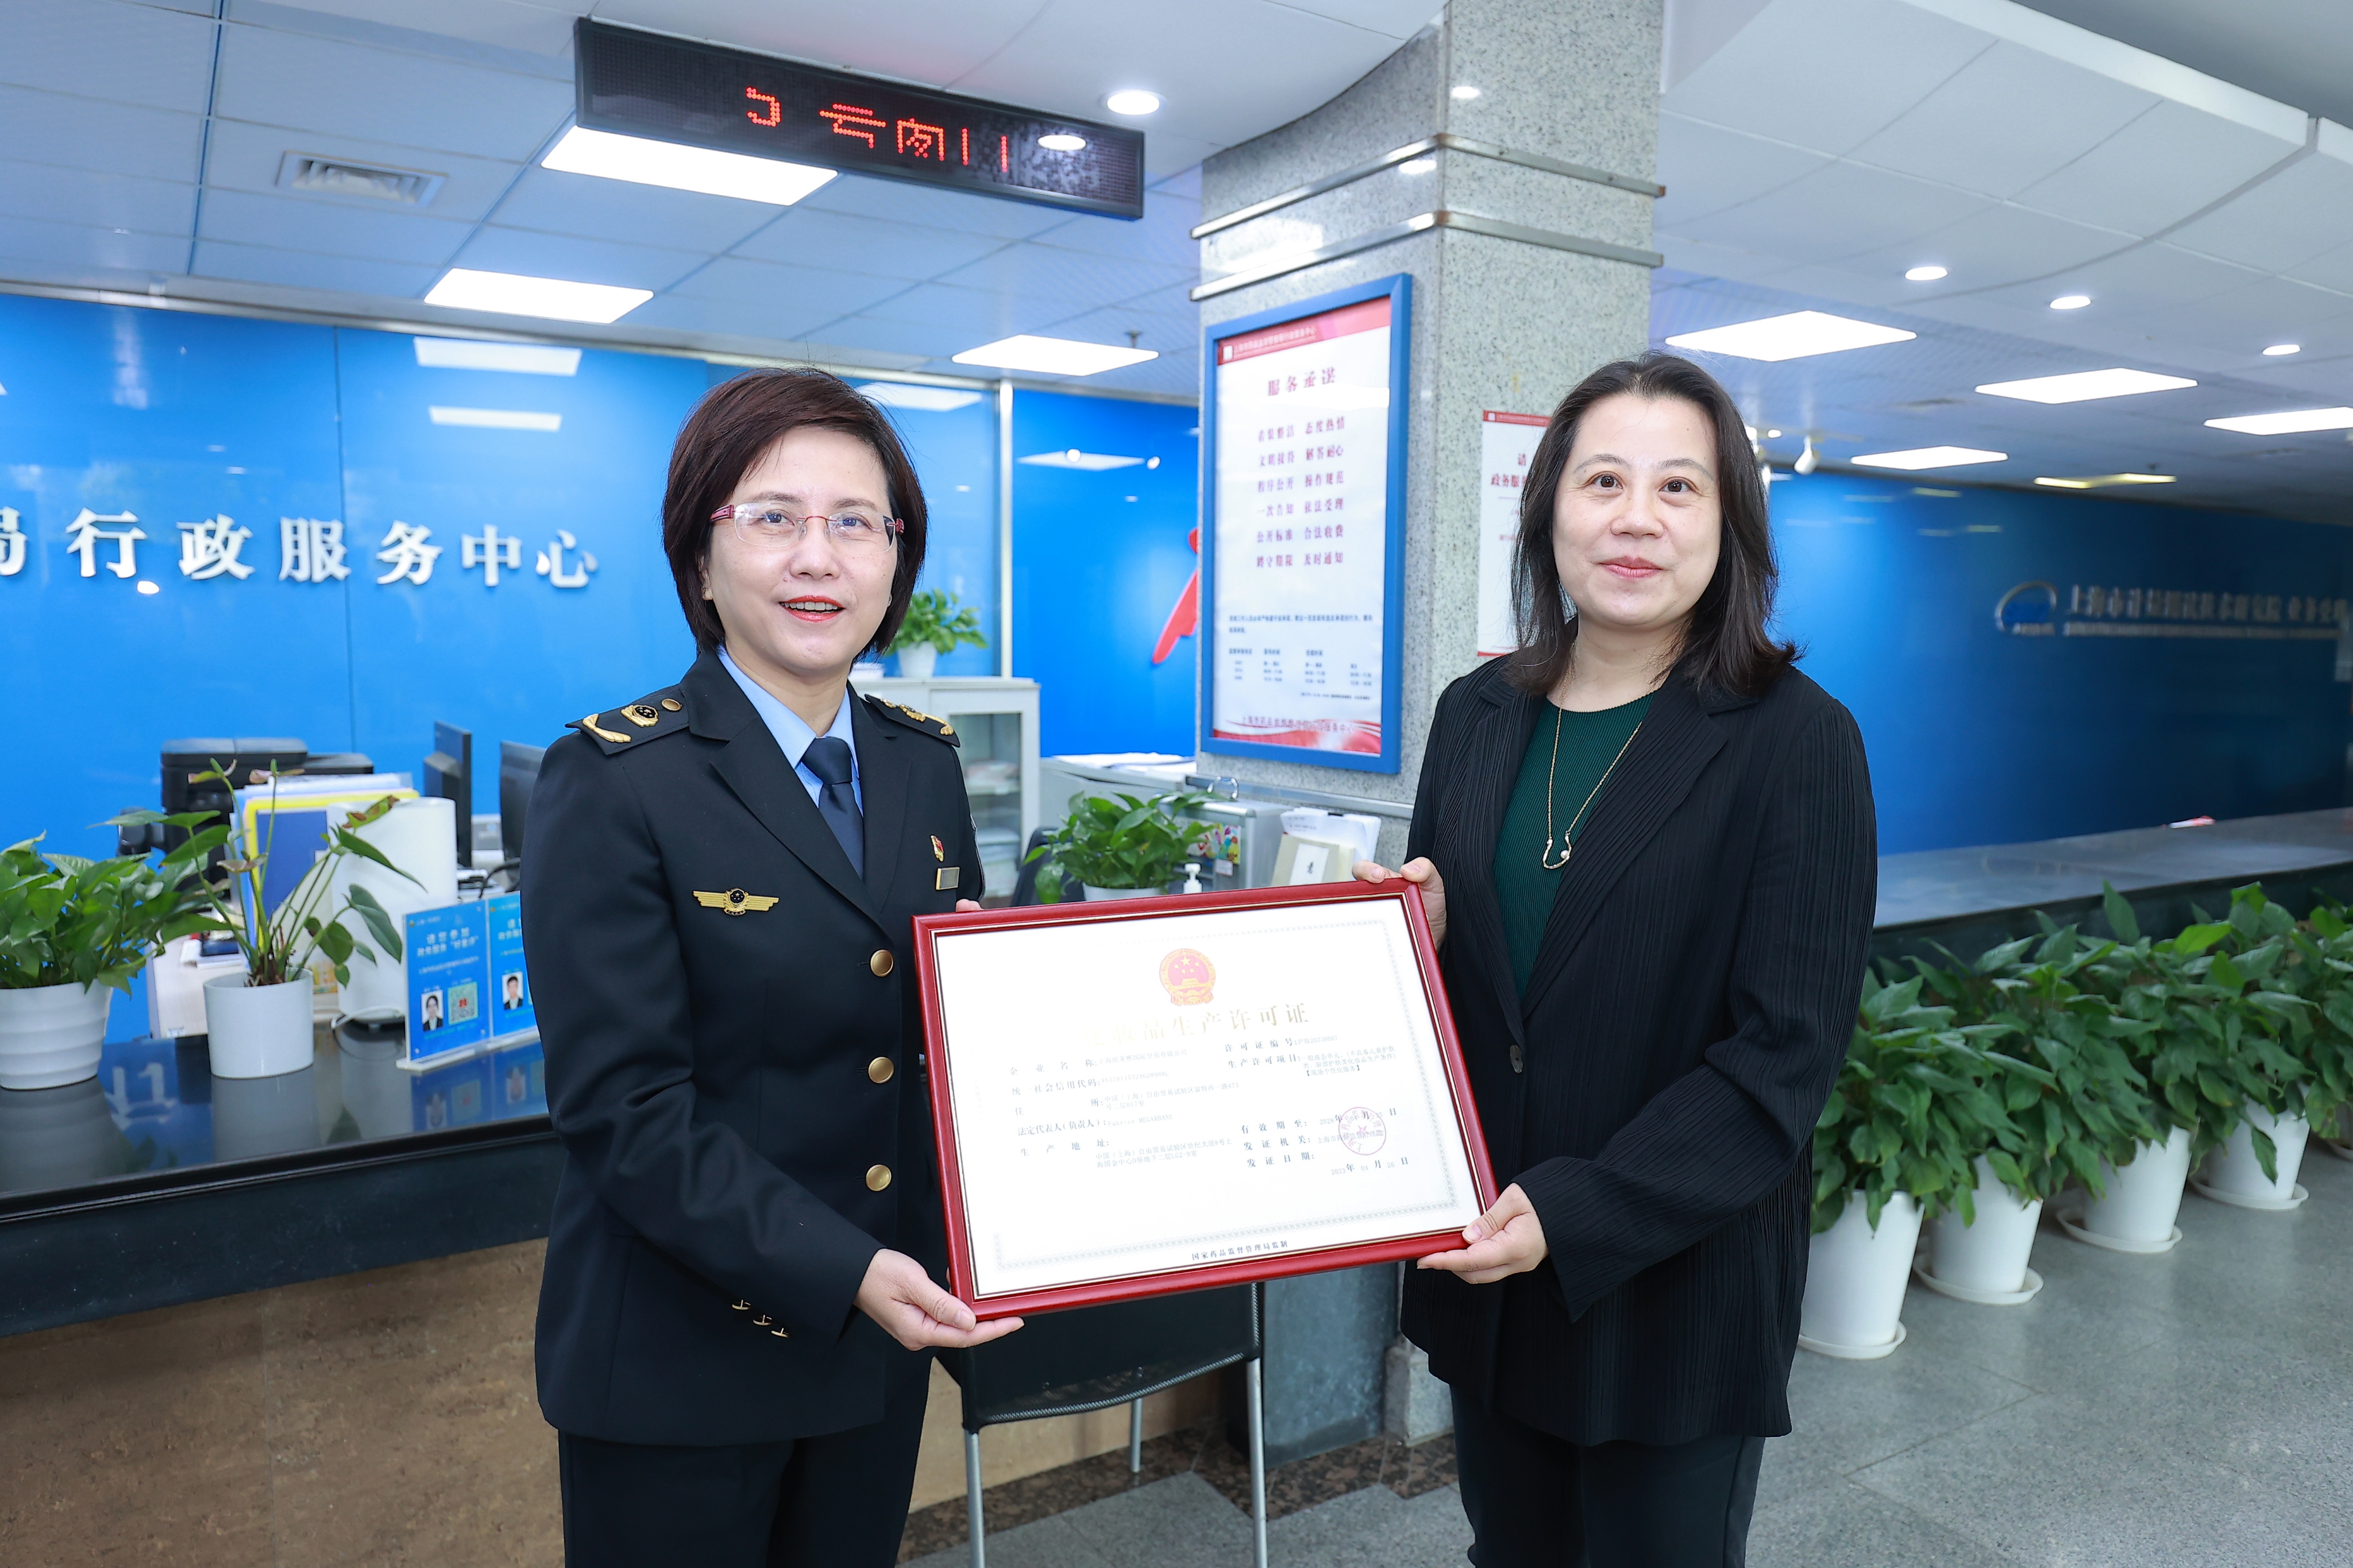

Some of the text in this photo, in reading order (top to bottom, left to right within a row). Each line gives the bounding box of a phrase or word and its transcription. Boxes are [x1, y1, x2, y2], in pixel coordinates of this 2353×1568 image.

[1099, 1049, 1187, 1064] 上海欧莱雅国际贸易有限公司
[1139, 1114, 1173, 1123] MEGARBANE
[1192, 1241, 1288, 1260] 国家药品监督管理局监制
